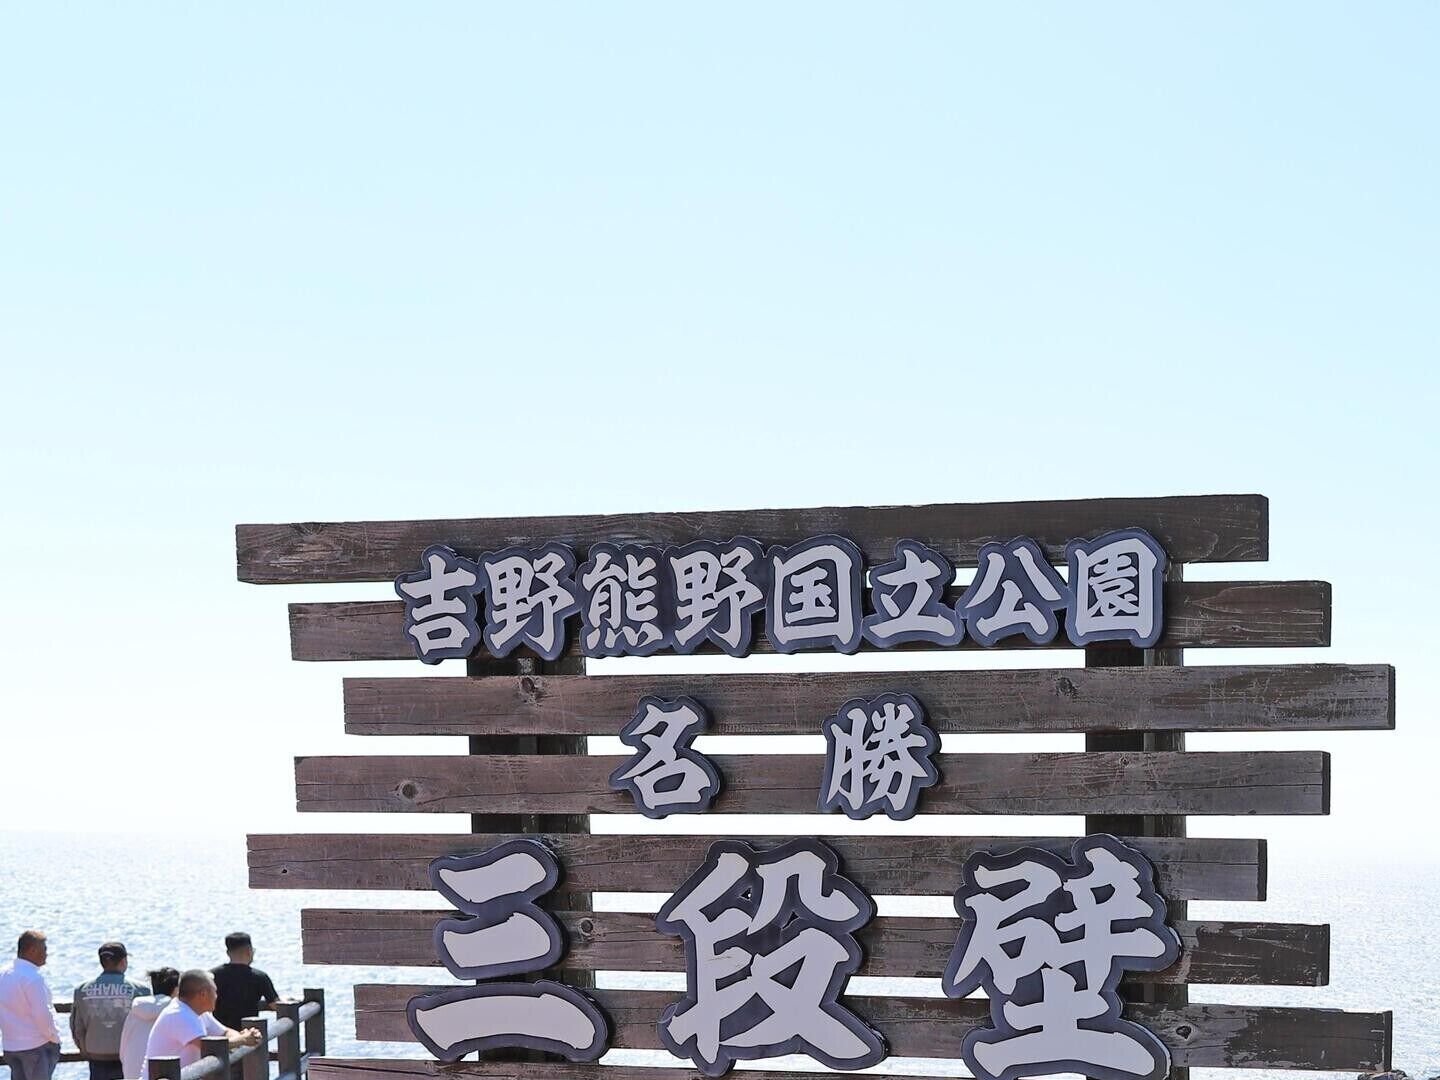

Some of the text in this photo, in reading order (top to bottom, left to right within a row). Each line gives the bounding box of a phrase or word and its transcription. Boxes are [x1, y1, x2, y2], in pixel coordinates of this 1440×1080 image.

[397, 533, 1164, 659] 吉野熊野国立公園
